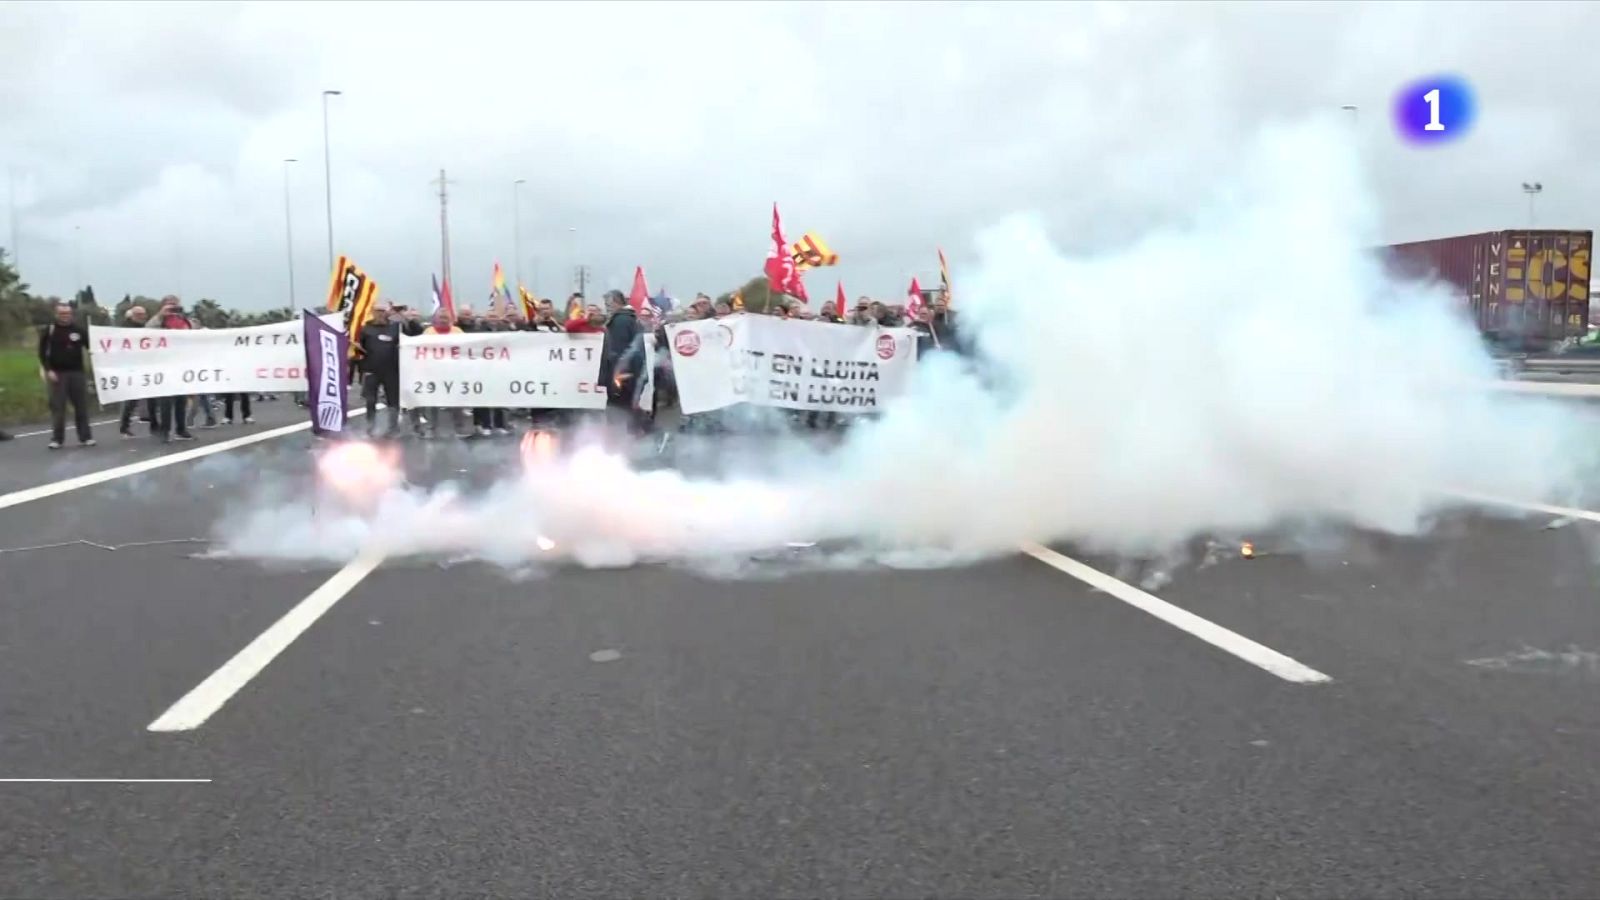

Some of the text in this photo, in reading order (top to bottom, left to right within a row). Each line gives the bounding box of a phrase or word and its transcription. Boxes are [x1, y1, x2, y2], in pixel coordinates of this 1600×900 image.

[99, 336, 168, 353] VAGA
[415, 346, 511, 361] HUELGA
[324, 336, 338, 397] CCOO
[772, 354, 803, 376] EN
[811, 358, 880, 381] LLUITA
[100, 376, 120, 390] 29
[141, 372, 164, 386] 30
[183, 369, 231, 383] OCT.
[509, 380, 557, 395] OCT.
[770, 379, 800, 402] EN
[808, 384, 877, 406] LUCHA
